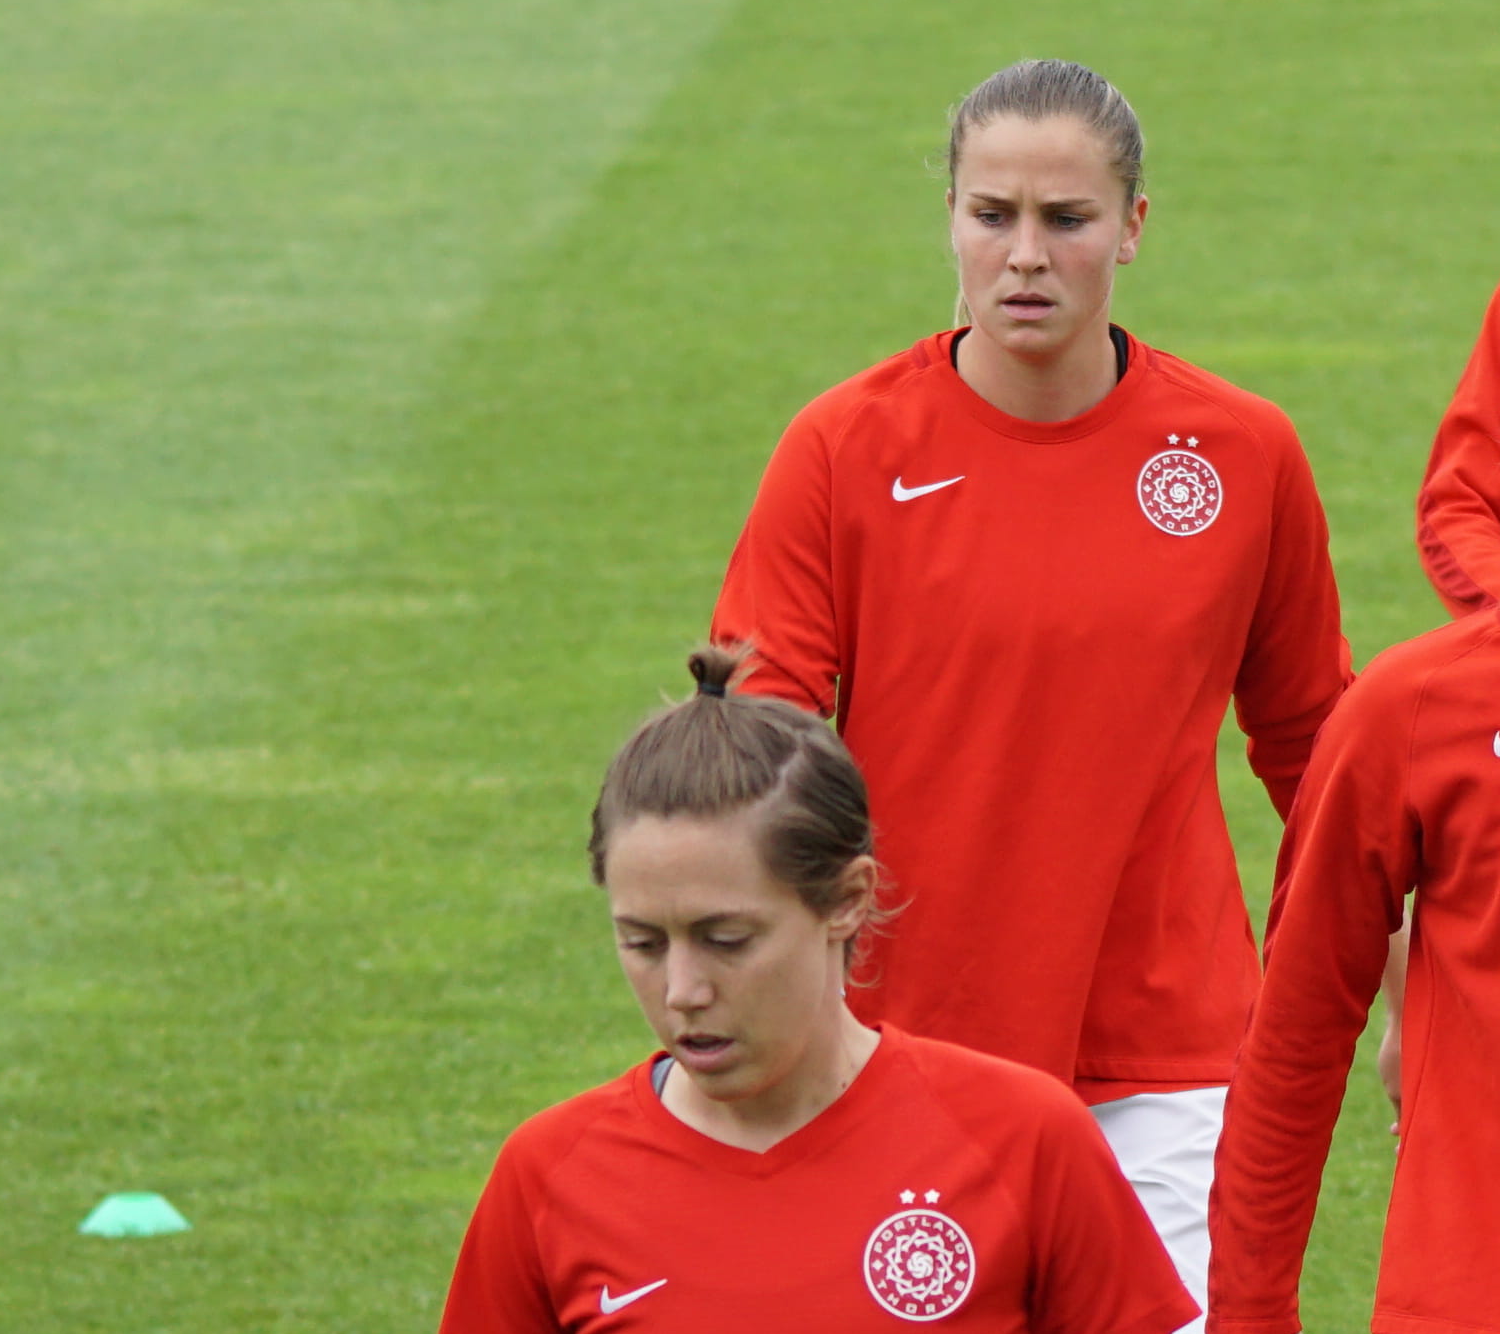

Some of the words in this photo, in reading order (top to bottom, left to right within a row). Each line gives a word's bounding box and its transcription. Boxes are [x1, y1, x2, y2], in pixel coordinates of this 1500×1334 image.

[1145, 455, 1216, 489] PORTLAND
[1147, 500, 1214, 531] THORNS
[873, 1216, 966, 1255] PORTLAND
[876, 1279, 965, 1315] THORNS
